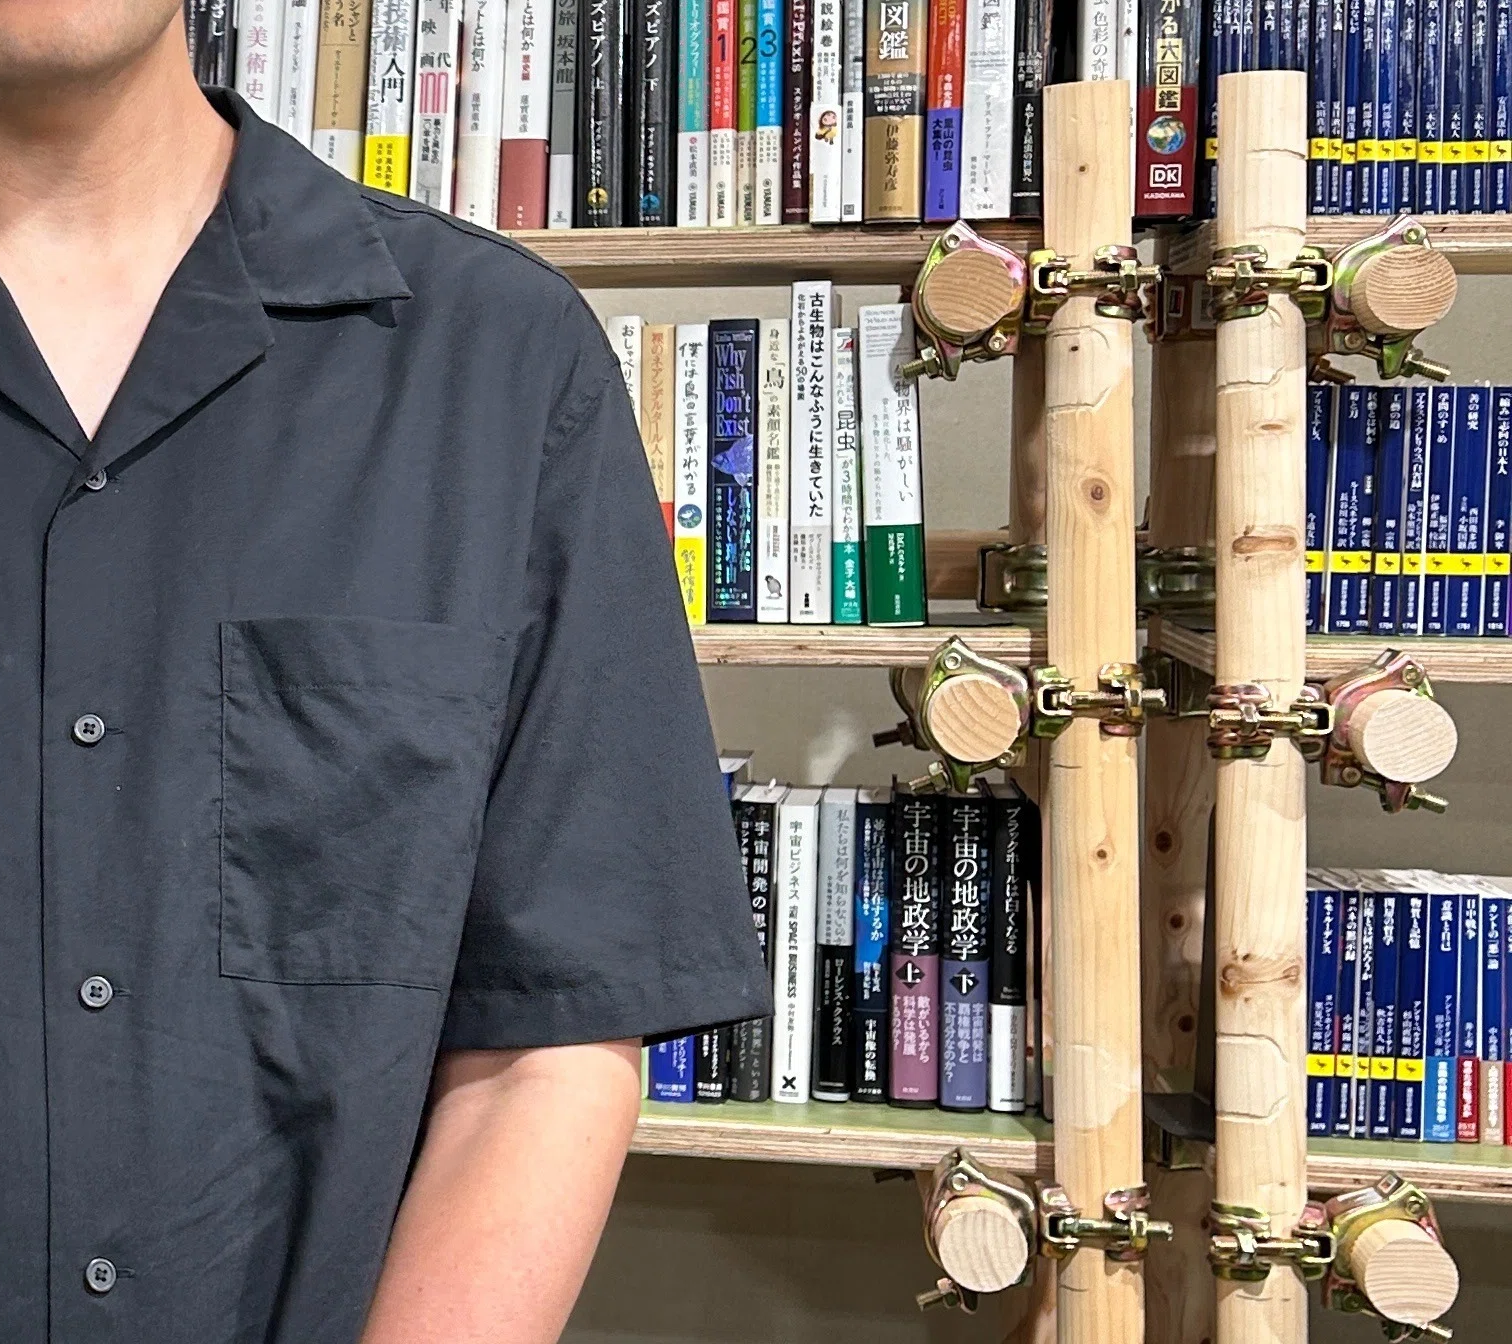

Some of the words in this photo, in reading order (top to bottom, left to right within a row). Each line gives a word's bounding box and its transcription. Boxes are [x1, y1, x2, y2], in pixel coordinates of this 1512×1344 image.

[245, 25, 269, 101] 美術史
[555, 33, 575, 93] 坂本龍一
[718, 33, 729, 63] 1
[741, 37, 758, 65] 2
[759, 29, 778, 57] 3
[592, 74, 606, 92] 上
[645, 75, 660, 92] 下
[1155, 38, 1183, 111] 大図鑑
[883, 122, 899, 192] 伊藤弥寿彦
[1152, 168, 1178, 186] DK
[715, 344, 747, 370] Why
[715, 369, 747, 398] Fish
[649, 331, 665, 457] 裸のネアンデルタール人
[678, 341, 704, 498] 僕には鳥の言葉がわかる
[715, 392, 751, 416] Don't
[763, 327, 786, 462] 身近な「鳥」の素顔名鑑
[807, 292, 825, 518] 古生物はこんなふうに生きていた
[1311, 391, 1322, 442] アリストテレス
[1348, 392, 1360, 420] 菊と刀
[1467, 393, 1480, 431] 善の研究
[715, 415, 751, 437] Exist
[1496, 392, 1511, 475] 「縮み」志向の日本人
[788, 820, 803, 902] 宇宙ビジネス
[870, 818, 886, 942] 並行宇宙は実在するか
[902, 802, 932, 957] 宇宙の地政学
[951, 805, 981, 962] 宇宙の地政学
[1004, 807, 1021, 955] ブラックホールは白くなる
[1322, 895, 1334, 955] ホモ・ルーデンス
[1408, 897, 1423, 950] 物質と記憶
[1464, 897, 1477, 941] 日中戦争
[903, 961, 922, 985] 上
[957, 971, 976, 993] 下
[916, 995, 931, 1063] 敵がいるから
[971, 1002, 984, 1063] 宇宙開発は
